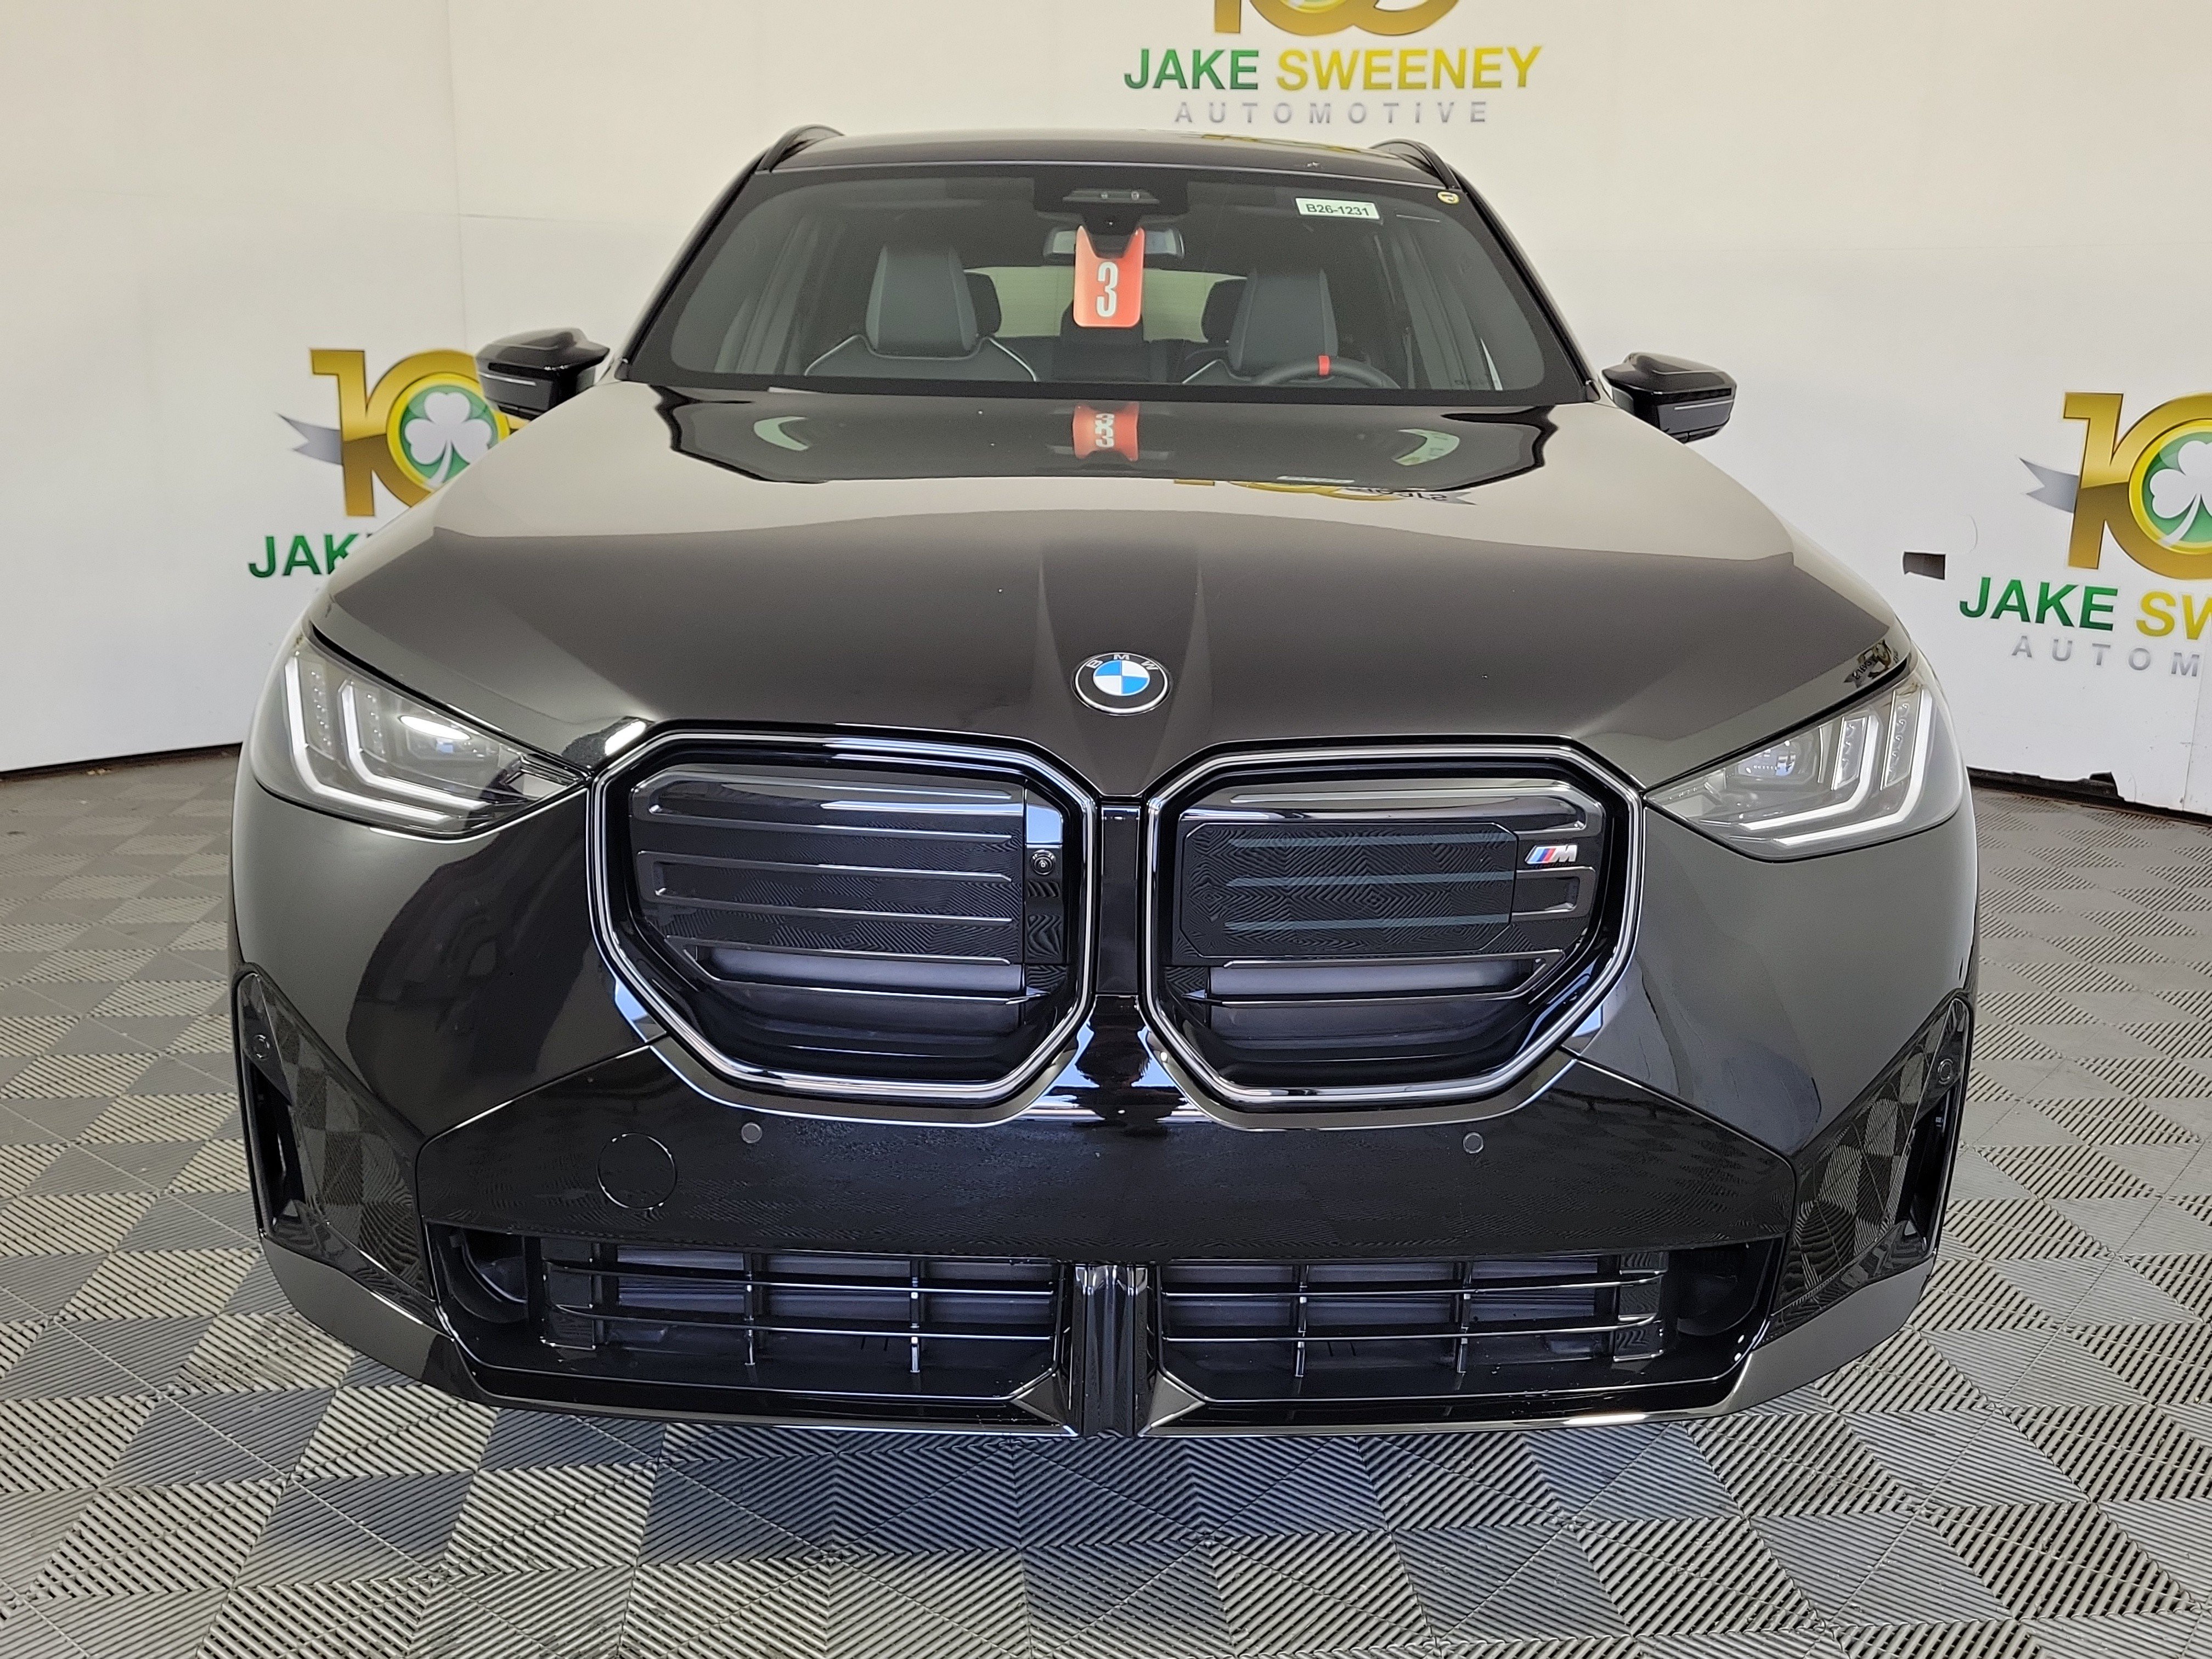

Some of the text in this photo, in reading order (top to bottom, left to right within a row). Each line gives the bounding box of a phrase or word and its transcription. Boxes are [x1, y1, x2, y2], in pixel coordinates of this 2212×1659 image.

[1123, 46, 1542, 91] JAKE SWEENEY
[1174, 101, 1487, 125] AUTOMOTIVE
[1306, 204, 1369, 216] B26-1231
[1097, 261, 1118, 317] 3
[310, 348, 531, 517] 10
[2063, 391, 2212, 580] 10
[249, 533, 371, 578] JAK
[1959, 577, 2118, 631] JAKE
[1086, 654, 1159, 670] BMW
[2011, 635, 2200, 677] AUTOM
[1545, 844, 1578, 863] M
